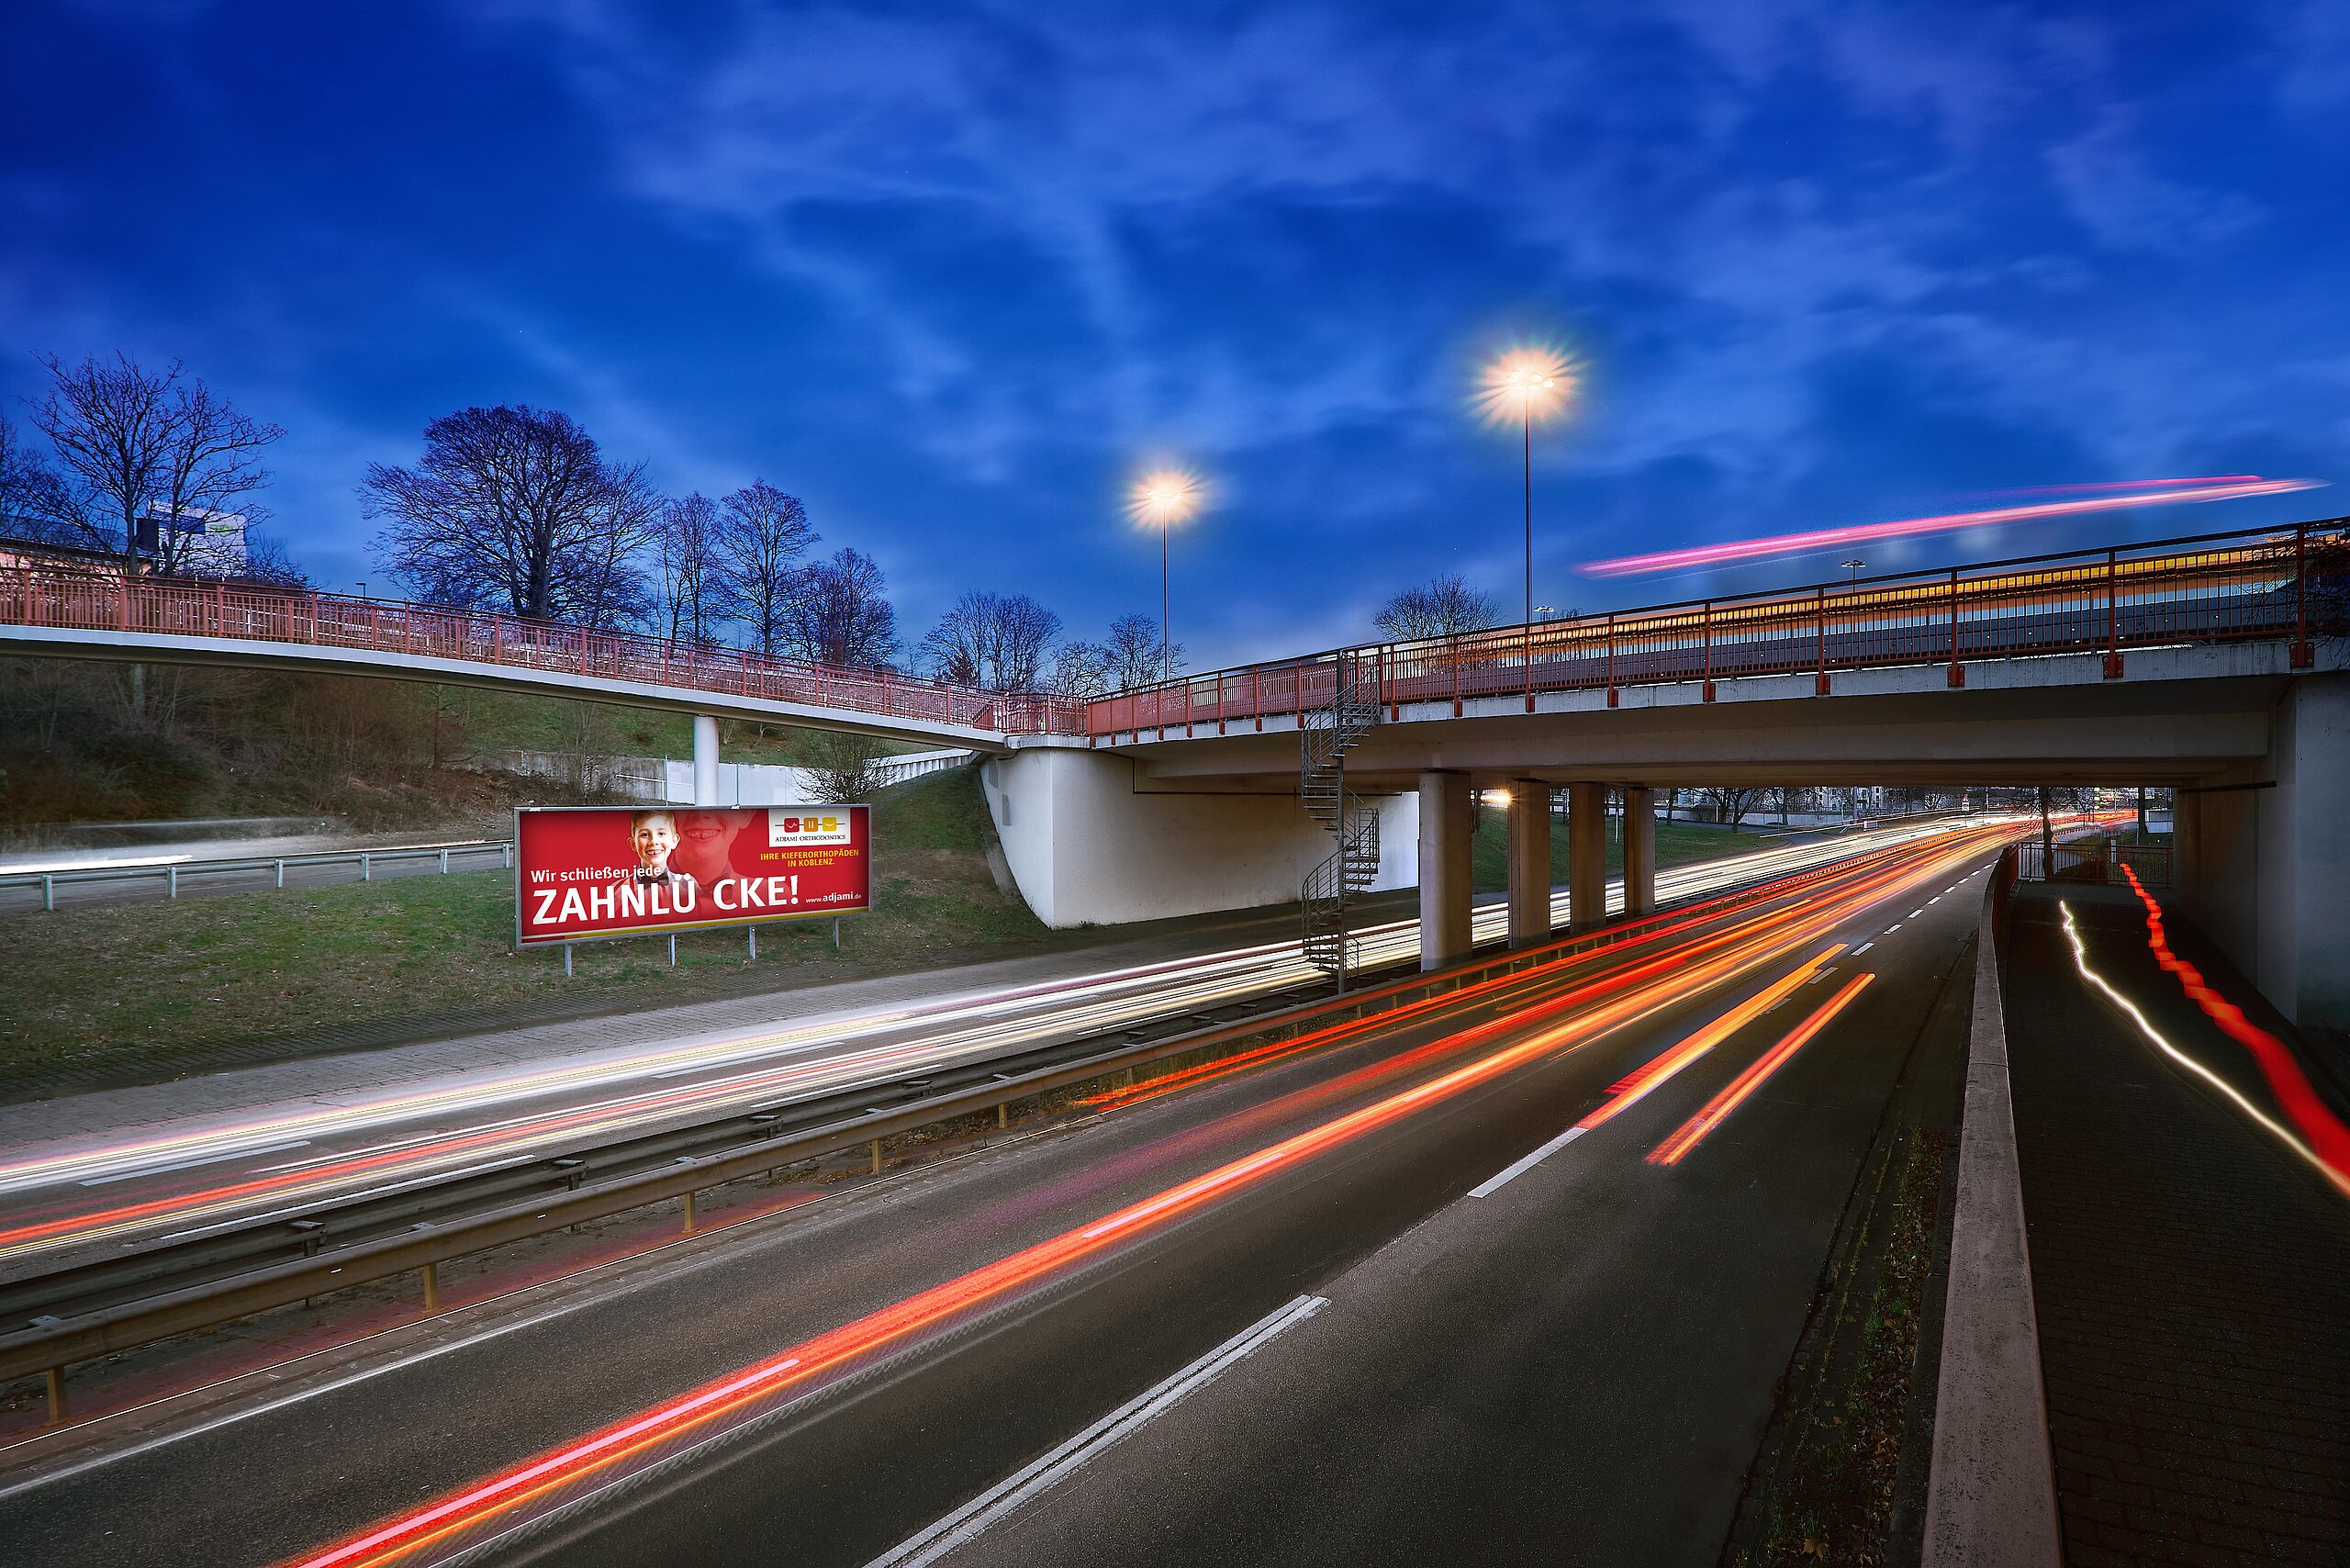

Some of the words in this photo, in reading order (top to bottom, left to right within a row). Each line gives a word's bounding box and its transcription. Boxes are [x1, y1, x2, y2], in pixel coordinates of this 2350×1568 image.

[799, 834, 846, 842] ORTHODONTICS
[760, 852, 779, 861] IHRE
[781, 848, 859, 860] KIEFERORTHOPÄDEN
[799, 858, 835, 867] KOBLENZ.
[531, 869, 556, 883] Wir
[560, 866, 630, 881] schließen
[632, 865, 662, 880] jede
[532, 873, 696, 925] ZAHNLÜ
[712, 875, 799, 911] CKE!
[805, 891, 862, 903] www.adjami.de
